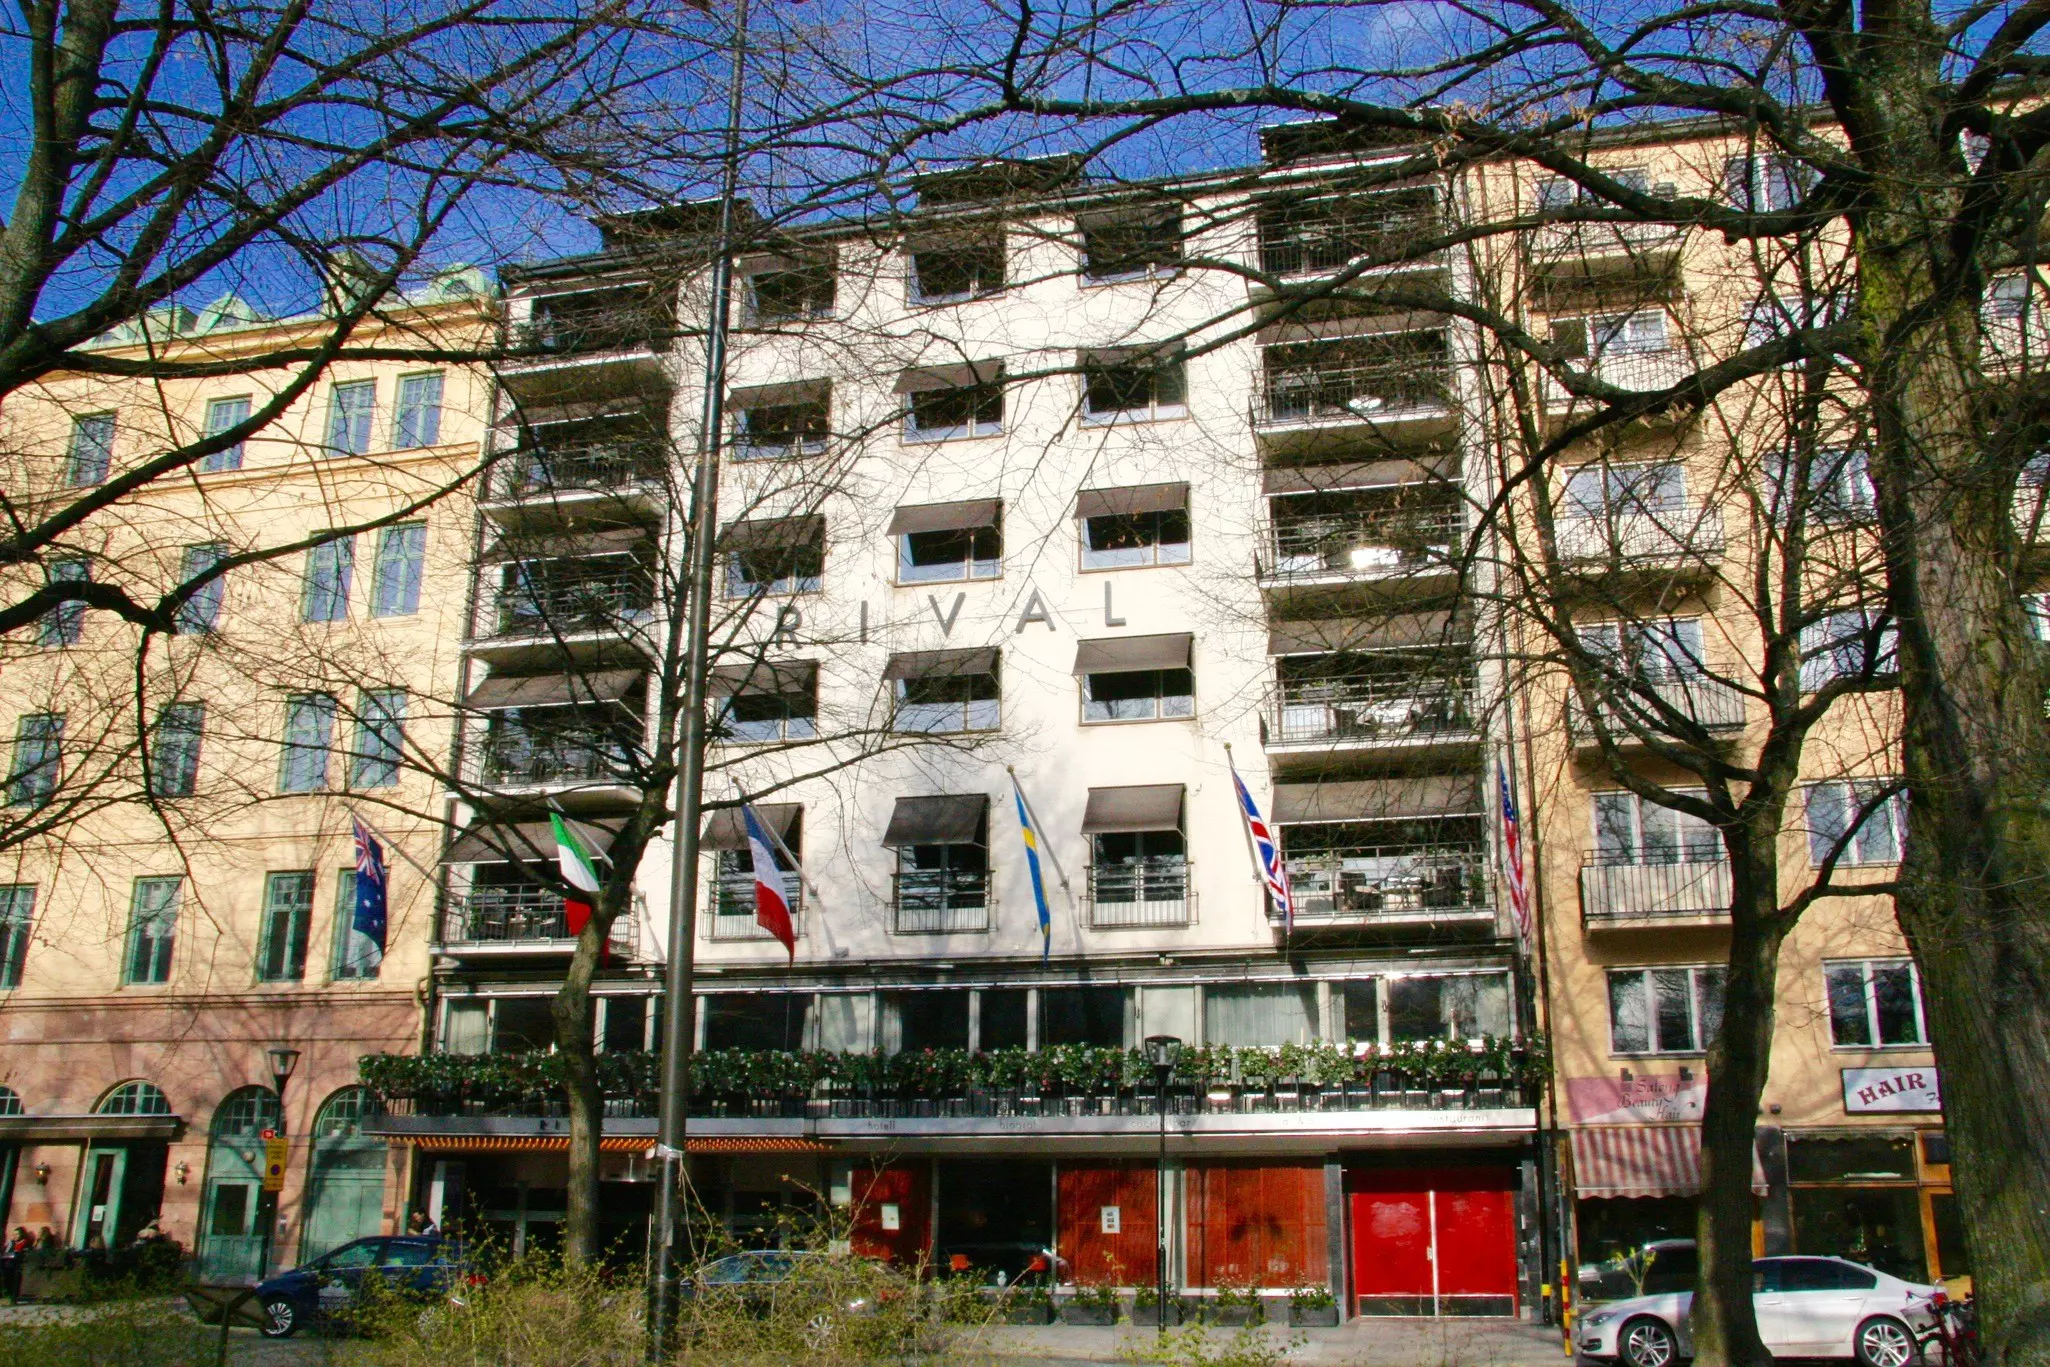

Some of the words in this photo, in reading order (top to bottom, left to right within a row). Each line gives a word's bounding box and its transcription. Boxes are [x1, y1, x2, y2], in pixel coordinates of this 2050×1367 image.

[775, 581, 1127, 651] RIVAL
[1857, 1073, 1926, 1105] HAIR
[1652, 1105, 1680, 1121] Hair
